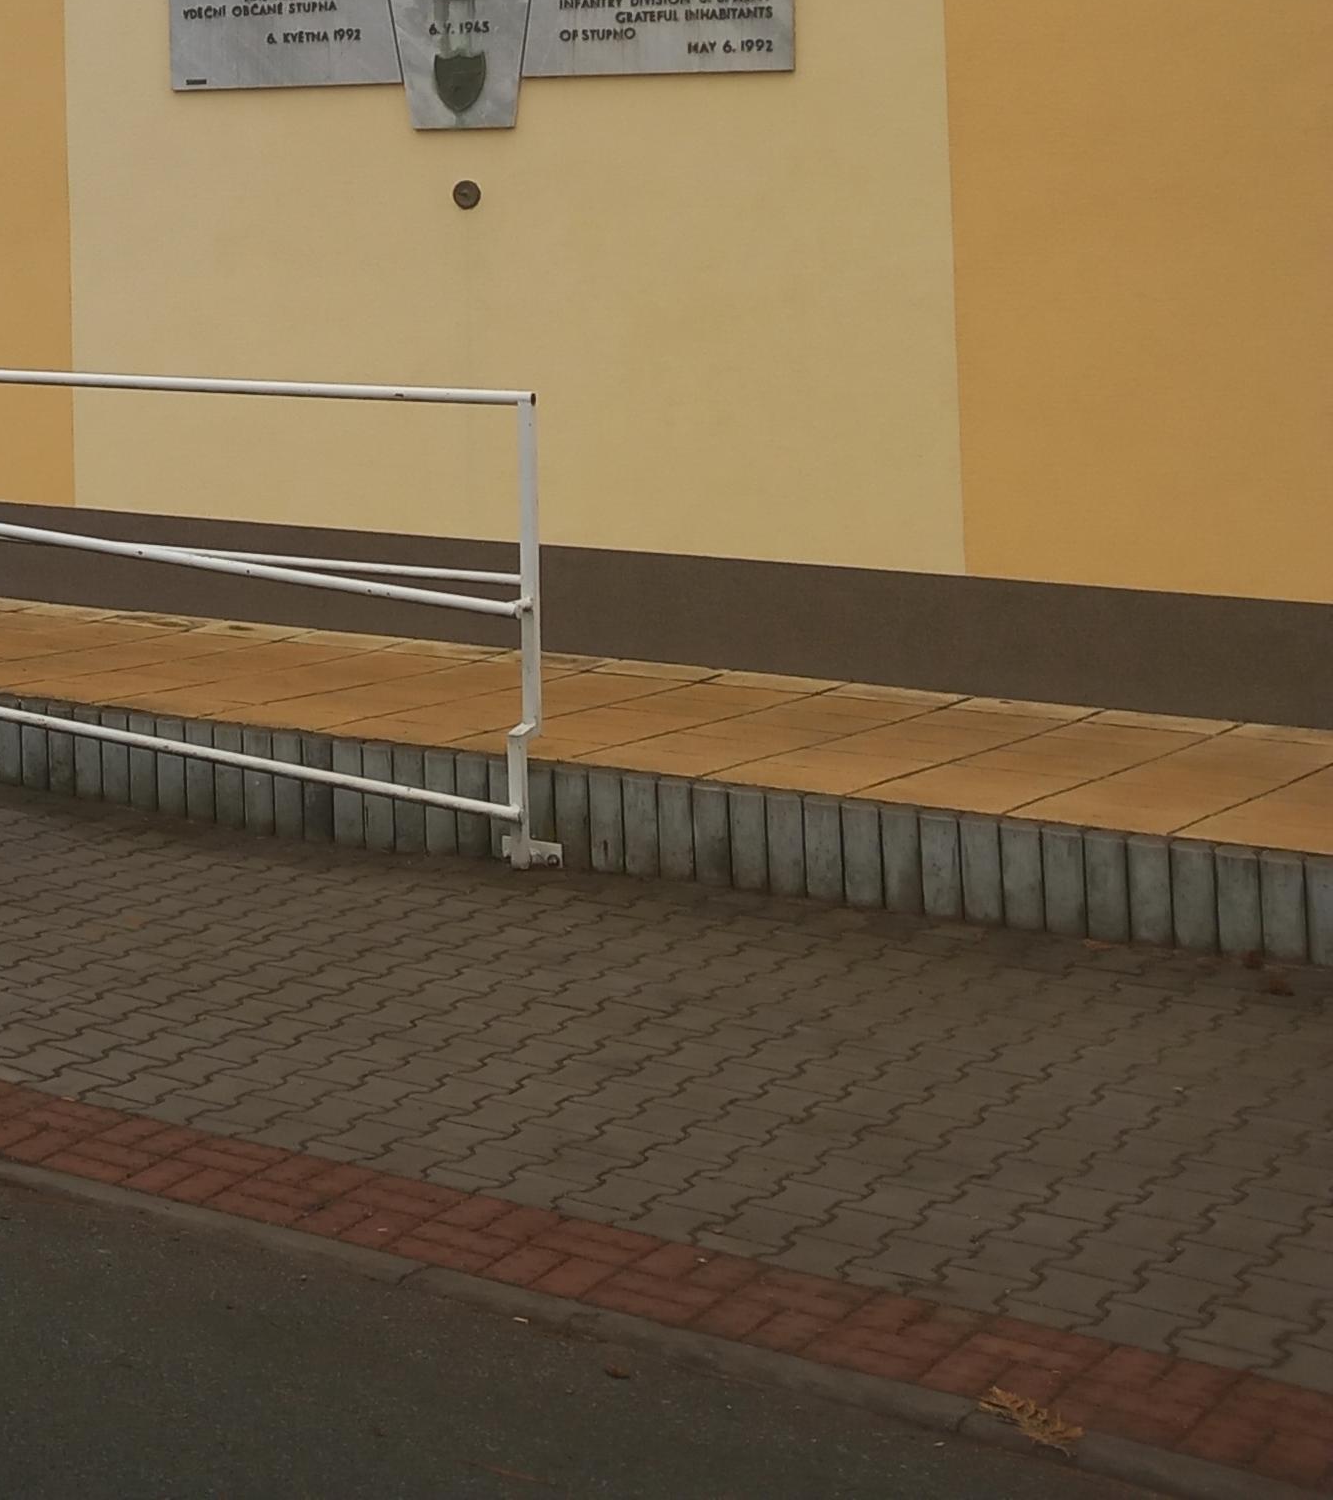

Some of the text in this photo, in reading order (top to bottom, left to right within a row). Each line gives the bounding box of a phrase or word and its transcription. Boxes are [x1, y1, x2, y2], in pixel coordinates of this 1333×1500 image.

[232, 2, 283, 17] OBČANÉ
[288, 0, 338, 14] STUPNA
[615, 6, 773, 24] GRATEFUL INHABITANTS
[333, 28, 361, 41] 1992
[459, 20, 490, 34] 1945
[559, 27, 636, 42] OF STUPNO
[687, 39, 773, 54] MAY 6. 1992
